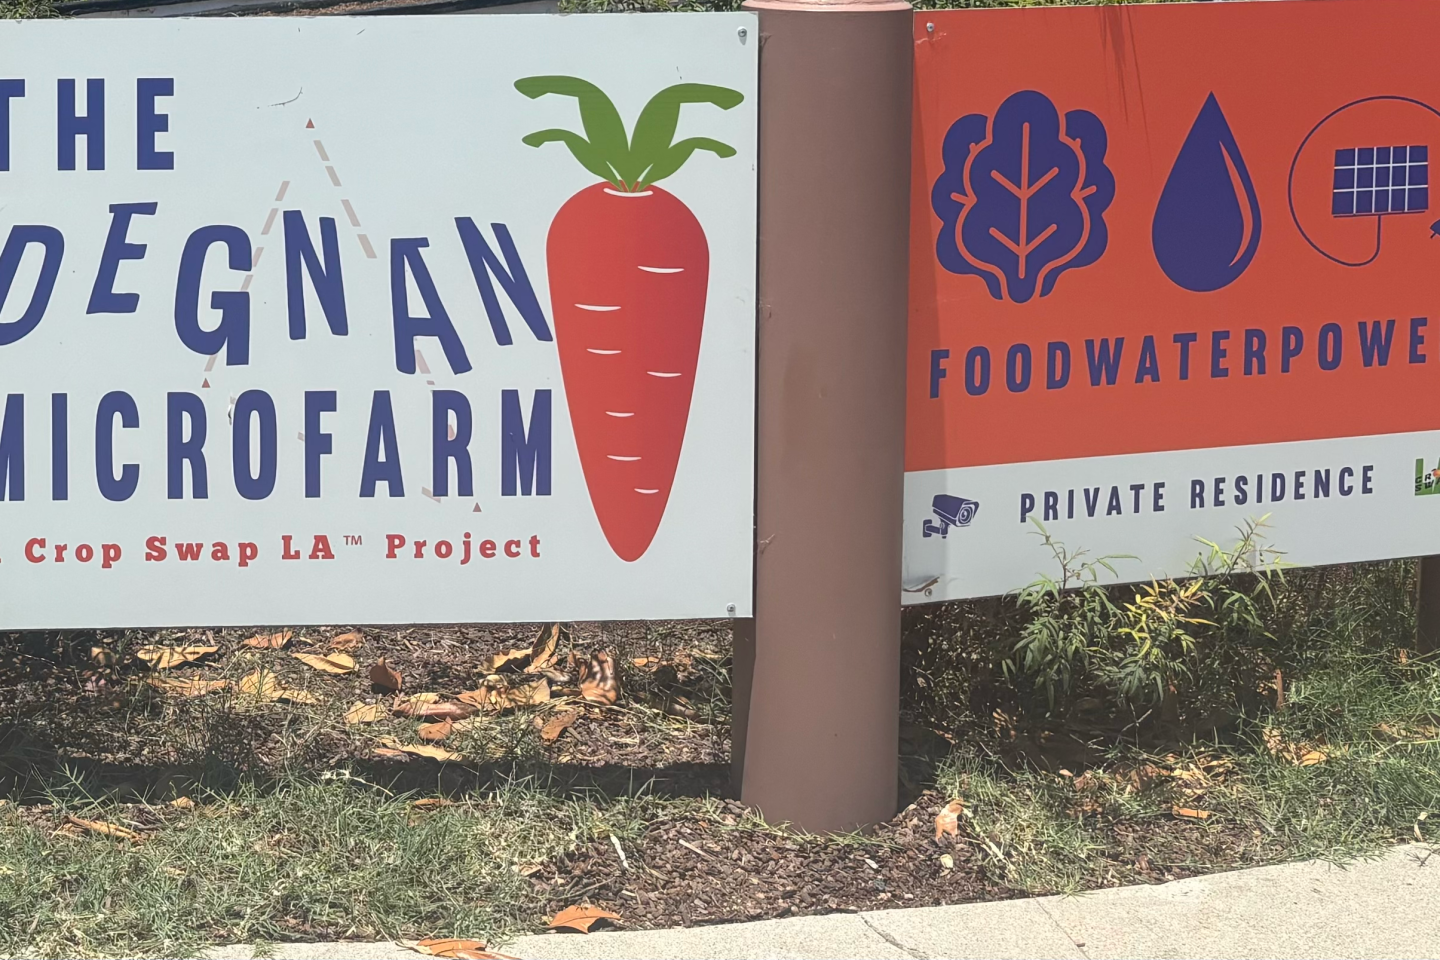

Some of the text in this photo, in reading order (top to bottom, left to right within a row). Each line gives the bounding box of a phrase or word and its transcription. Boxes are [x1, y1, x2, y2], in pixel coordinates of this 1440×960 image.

[1020, 464, 1375, 524] PRIVATE RESIDENCE
[24, 537, 123, 570] Crop
[145, 535, 259, 567] Swap
[385, 532, 542, 565] Project
